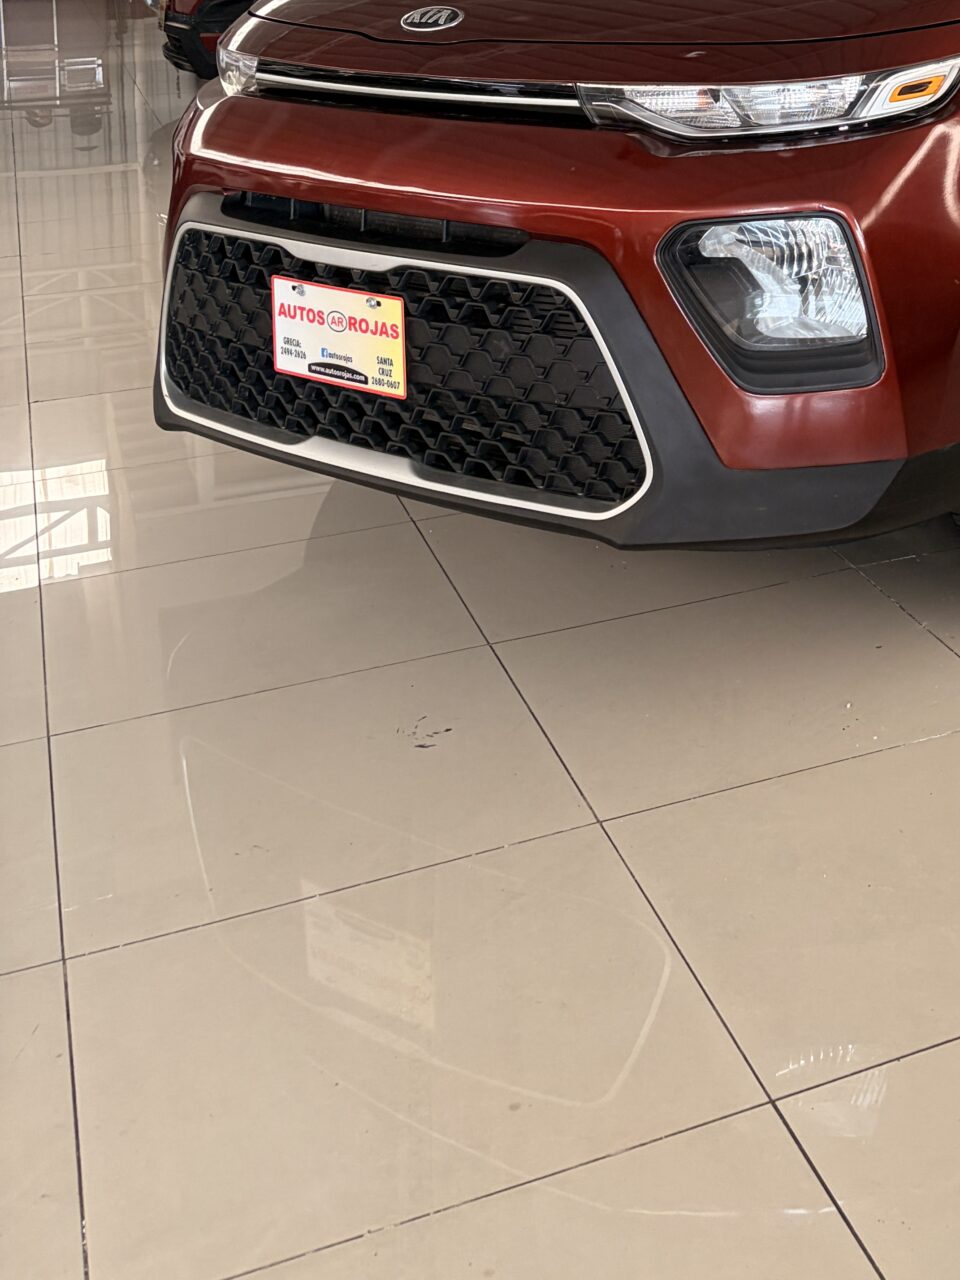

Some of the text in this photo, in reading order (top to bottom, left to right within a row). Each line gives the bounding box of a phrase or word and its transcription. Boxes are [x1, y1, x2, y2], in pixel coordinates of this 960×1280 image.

[406, 7, 452, 25] KIA
[278, 302, 400, 340] AUTOS AR ROJAS
[376, 355, 394, 367] SANTA
[378, 367, 393, 378] CRUZ
